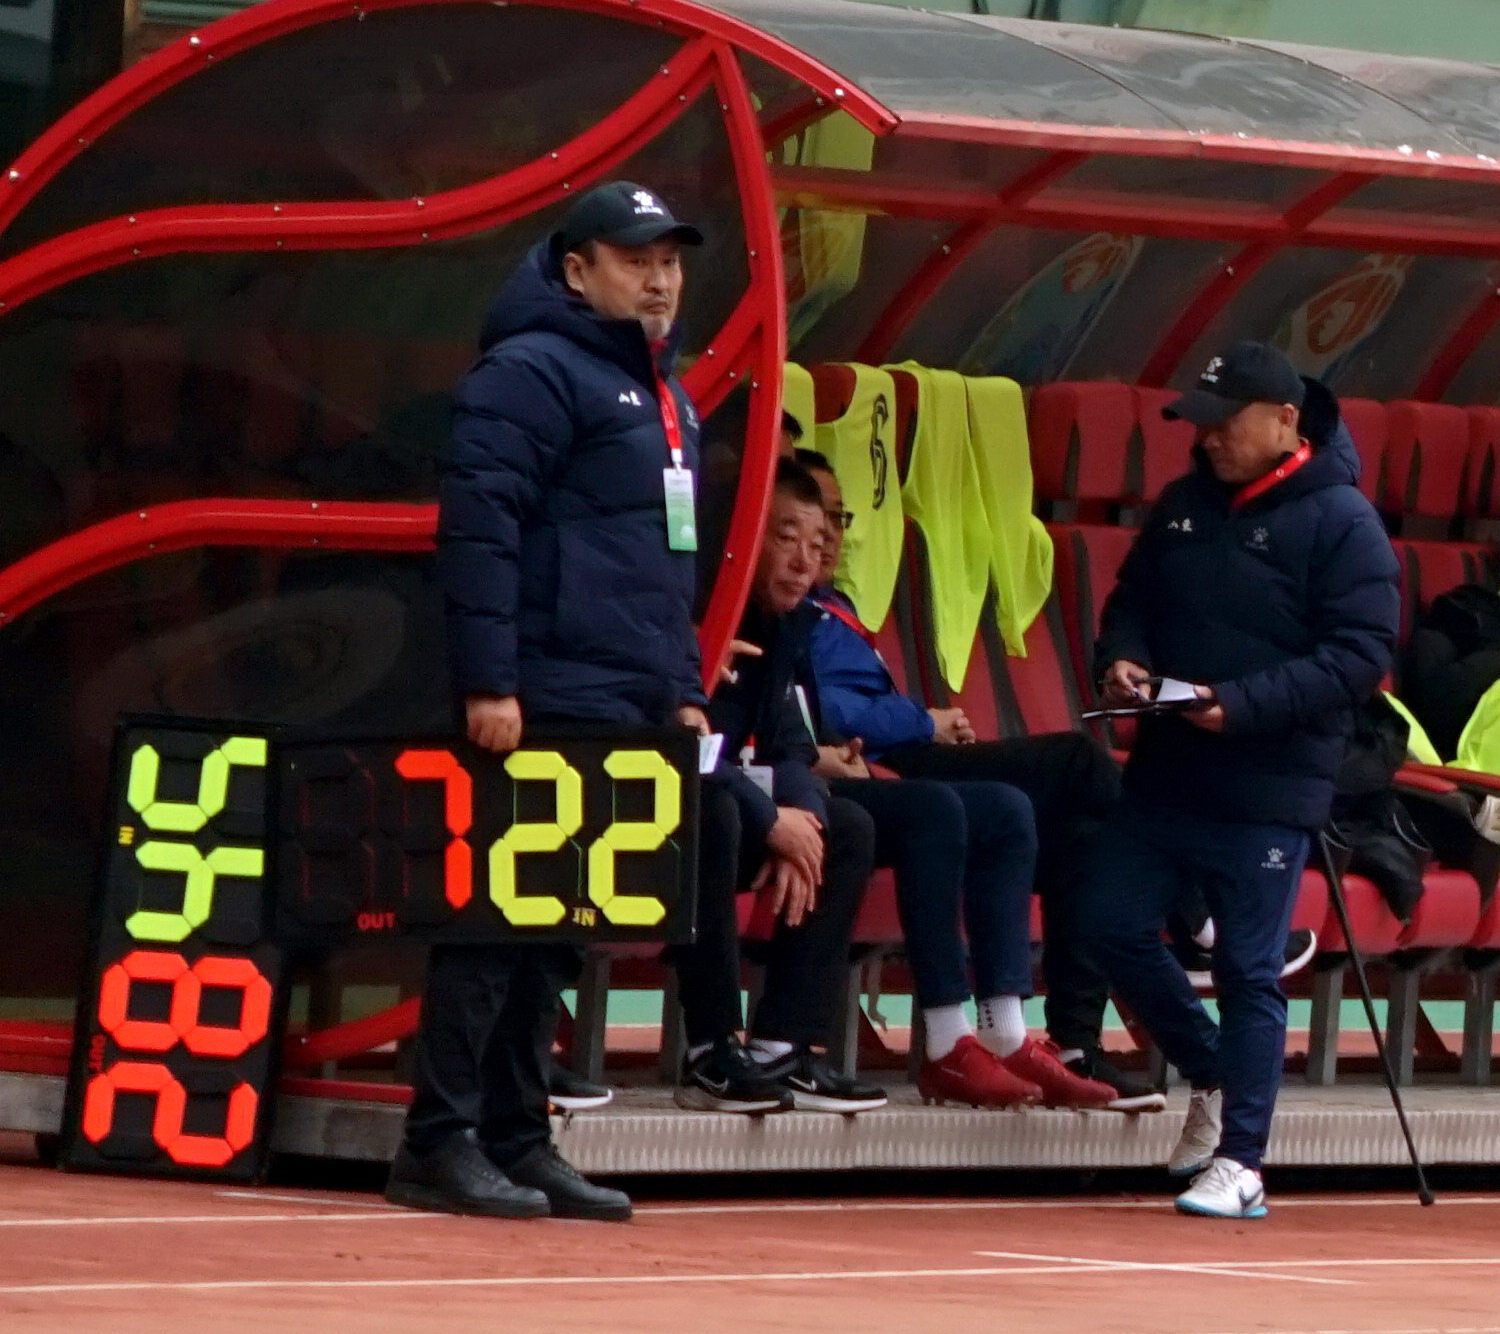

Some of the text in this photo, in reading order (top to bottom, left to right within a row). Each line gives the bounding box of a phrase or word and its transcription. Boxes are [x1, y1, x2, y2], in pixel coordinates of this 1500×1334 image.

[489, 749, 681, 926] 22
[357, 912, 395, 930] OUT
[572, 906, 597, 927] IN
